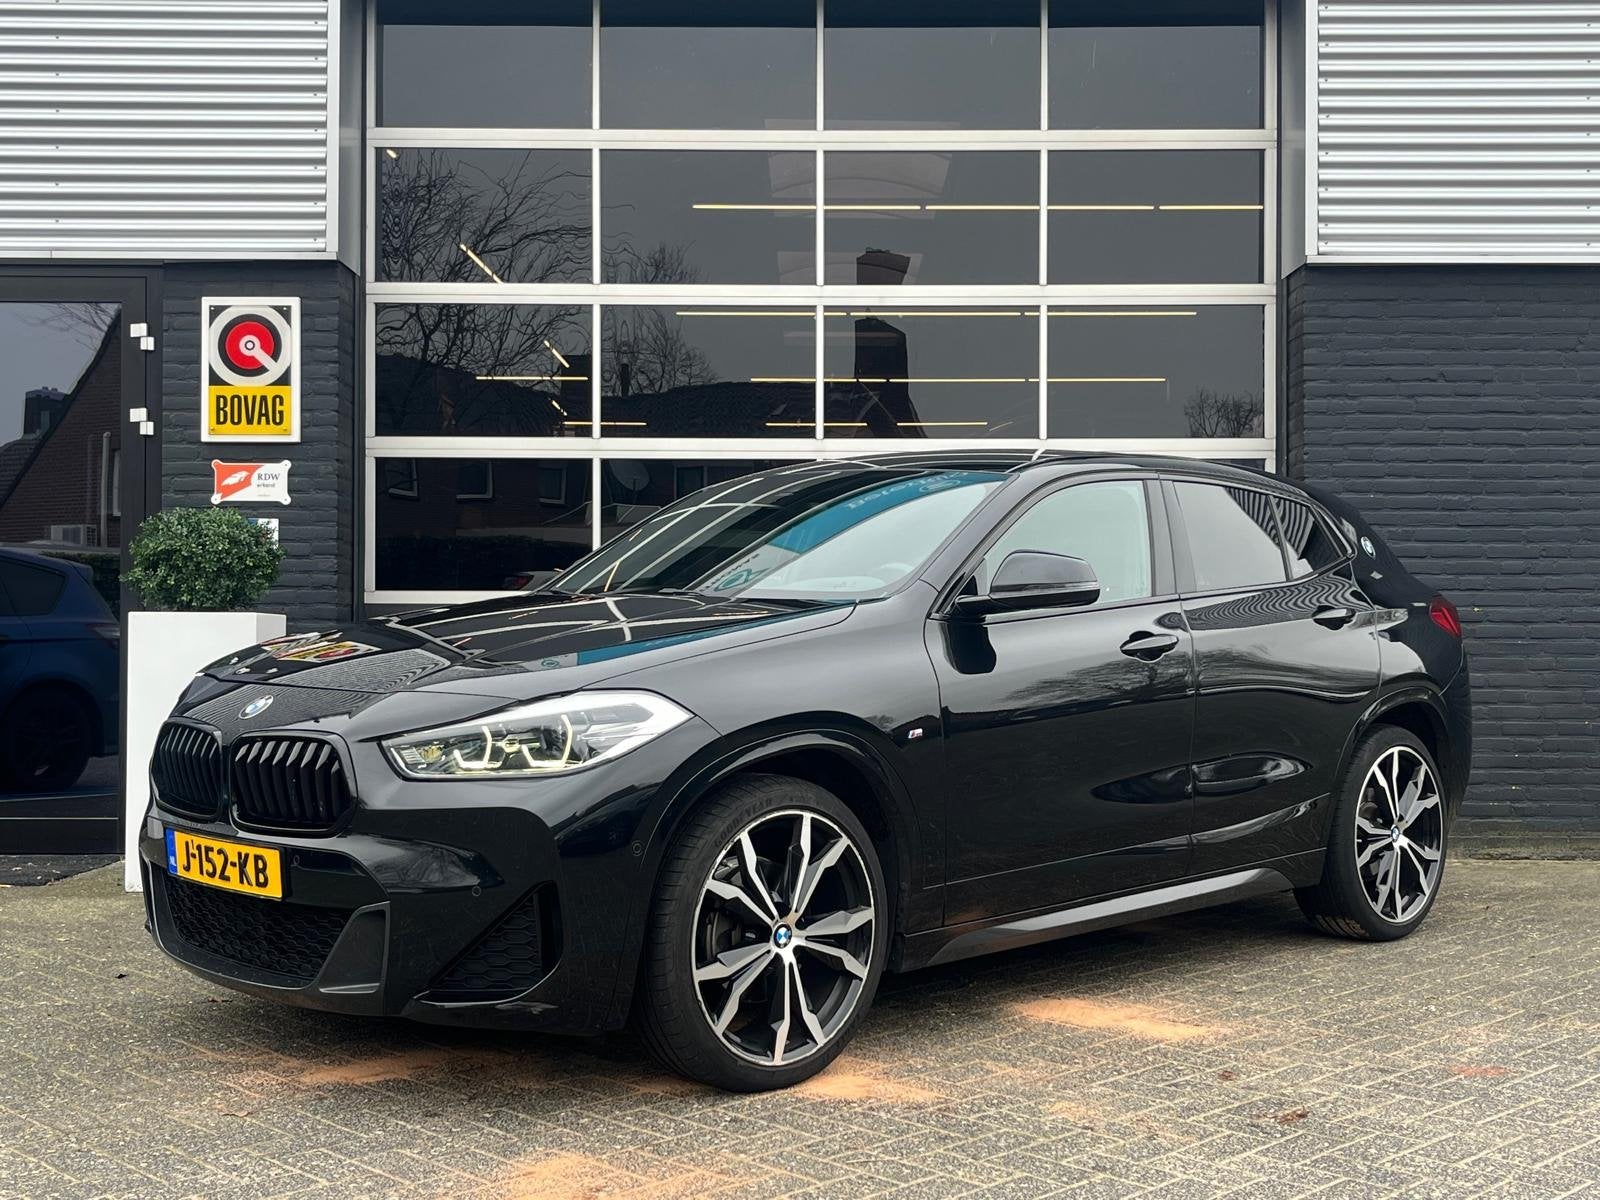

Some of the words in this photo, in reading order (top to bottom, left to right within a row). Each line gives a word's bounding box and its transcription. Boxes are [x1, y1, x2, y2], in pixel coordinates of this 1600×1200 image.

[215, 394, 284, 426] BOVAG
[257, 472, 281, 481] RDW
[182, 840, 269, 888] J-152-KB
